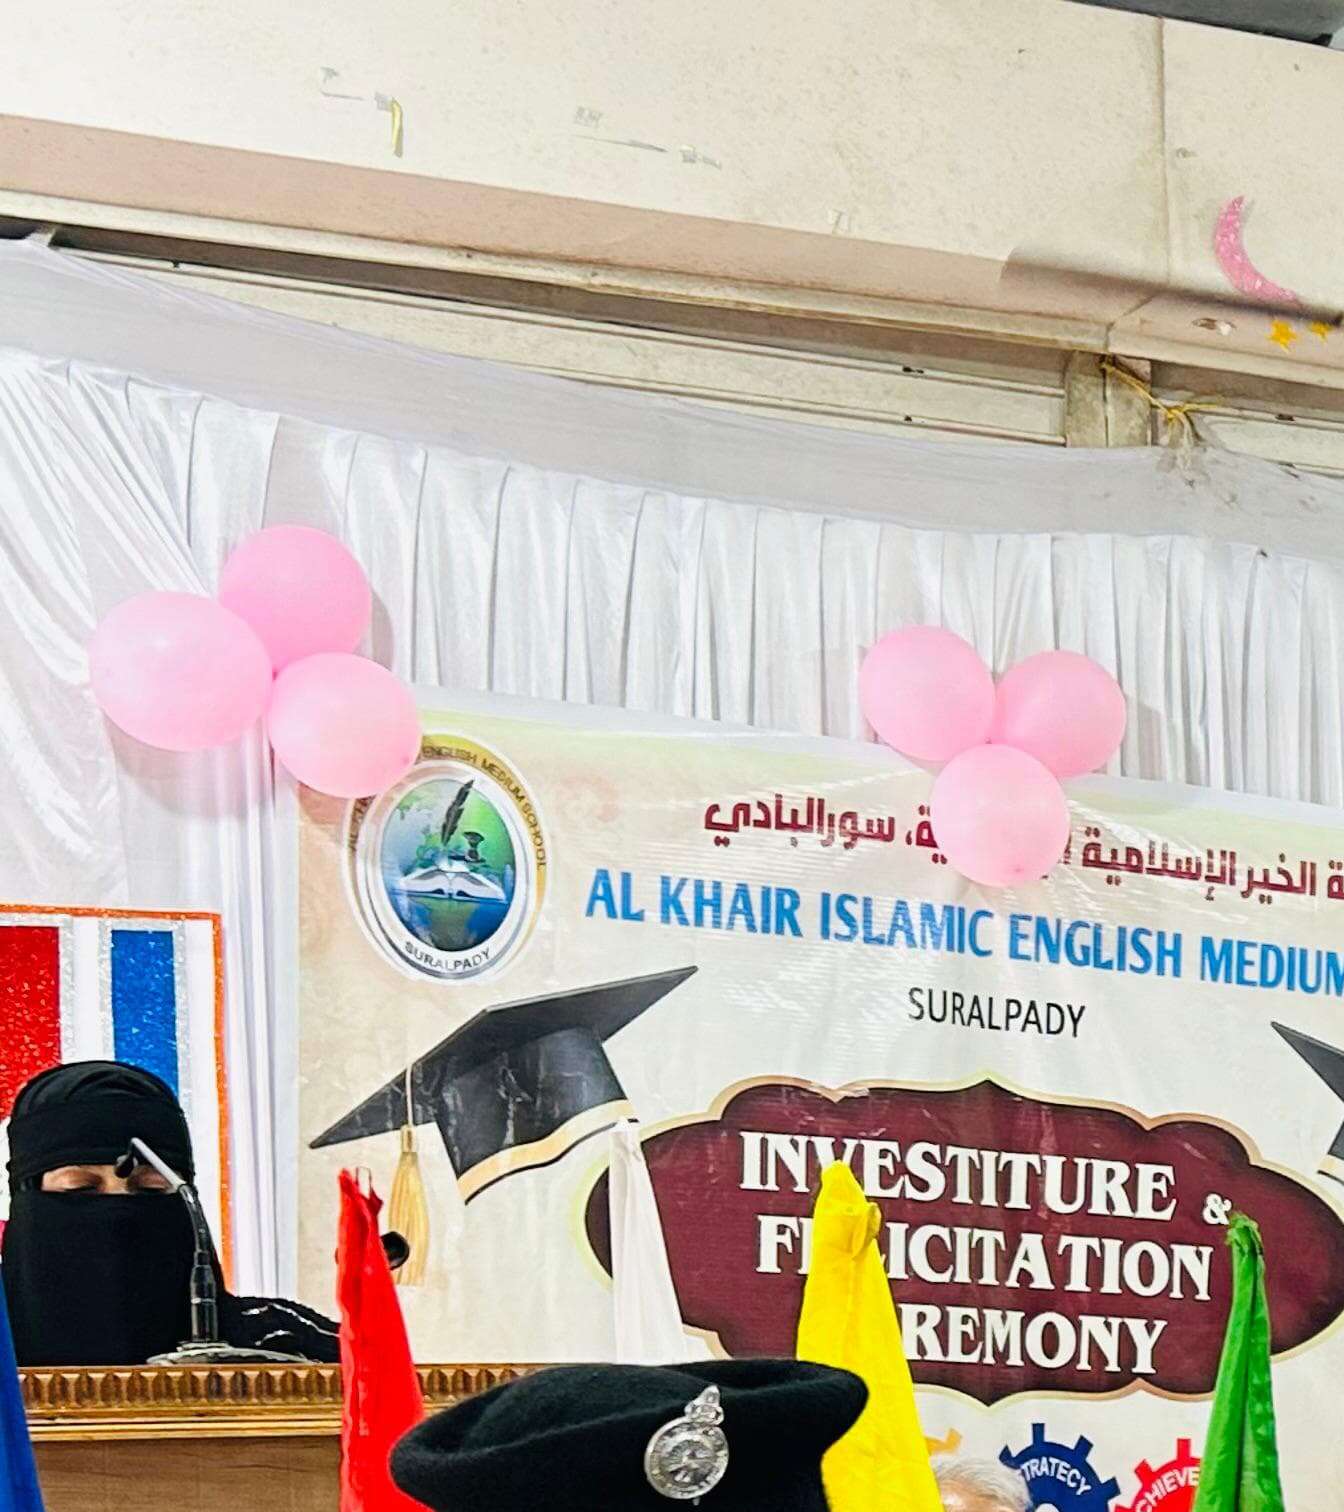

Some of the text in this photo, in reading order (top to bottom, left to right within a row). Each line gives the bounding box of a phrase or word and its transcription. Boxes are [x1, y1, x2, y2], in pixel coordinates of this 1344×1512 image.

[481, 754, 525, 803] MEDIUM
[522, 803, 547, 868] SCHOOL
[404, 941, 490, 971] SURALPADY
[586, 868, 645, 923] AL
[659, 875, 802, 938] KHAIR
[819, 893, 993, 958] ISLAMIC
[1007, 913, 1183, 978] ENGLISH
[908, 986, 1086, 1038] SURALPADY
[739, 1131, 1232, 1225] INVESTITURE &
[755, 1214, 1214, 1301] FICITATION
[898, 1302, 1168, 1375] REMONY
